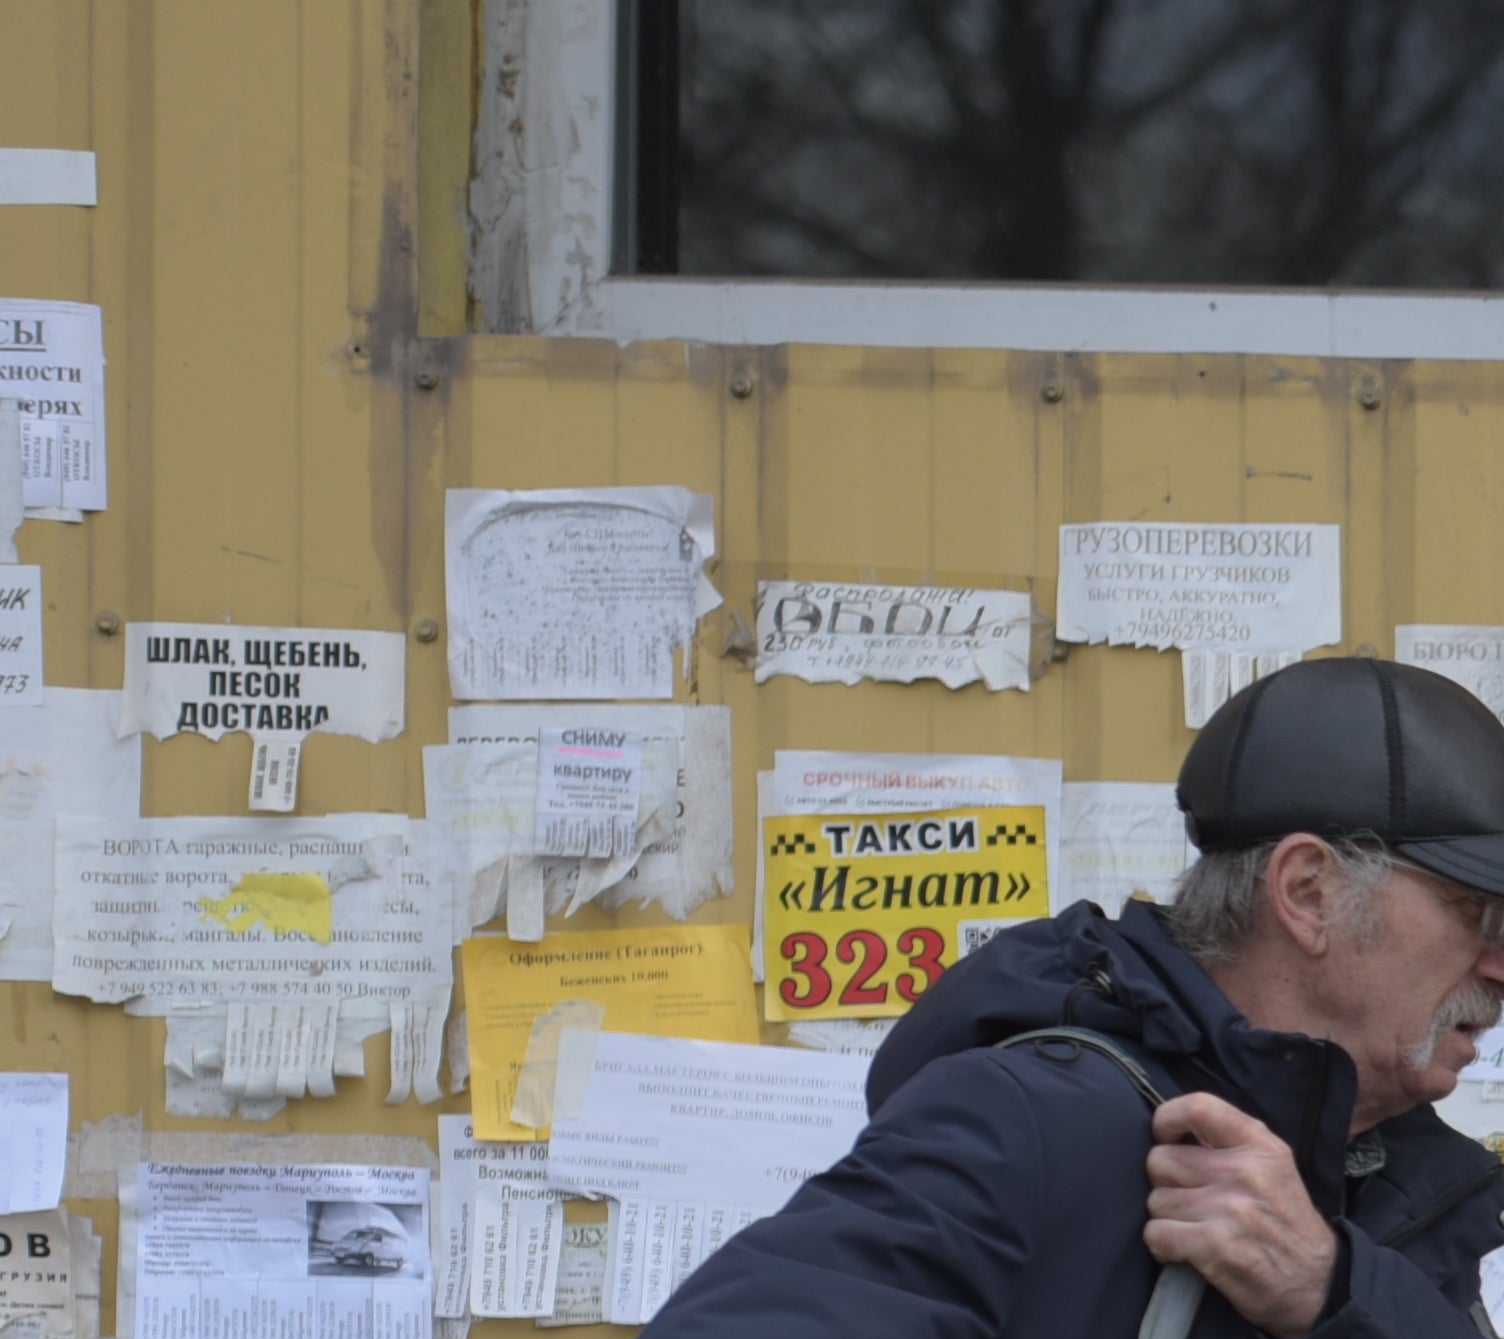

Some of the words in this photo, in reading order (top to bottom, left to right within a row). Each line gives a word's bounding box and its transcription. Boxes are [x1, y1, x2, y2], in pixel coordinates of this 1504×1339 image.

[1064, 527, 1313, 558] ГРУЗОПЕРЕВОЗКИ
[1083, 562, 1165, 584] УСЛУГИ
[1170, 564, 1290, 584] ГРУЗЧИКОВ
[1087, 588, 1163, 605] БЫСТРО,
[1168, 589, 1280, 606] АККУРАТНО,
[147, 637, 237, 666] ШЛАК,
[244, 638, 368, 672] ЩЕБЕНЬ,
[209, 671, 301, 698] ПЕСОК
[177, 704, 330, 732] ДОСТАВКА
[561, 729, 627, 749] СНИМУ
[553, 763, 632, 785] квартиру
[825, 822, 976, 857] ТАКСИ
[778, 865, 1031, 912] «Игнат»
[779, 927, 948, 1008] 323
